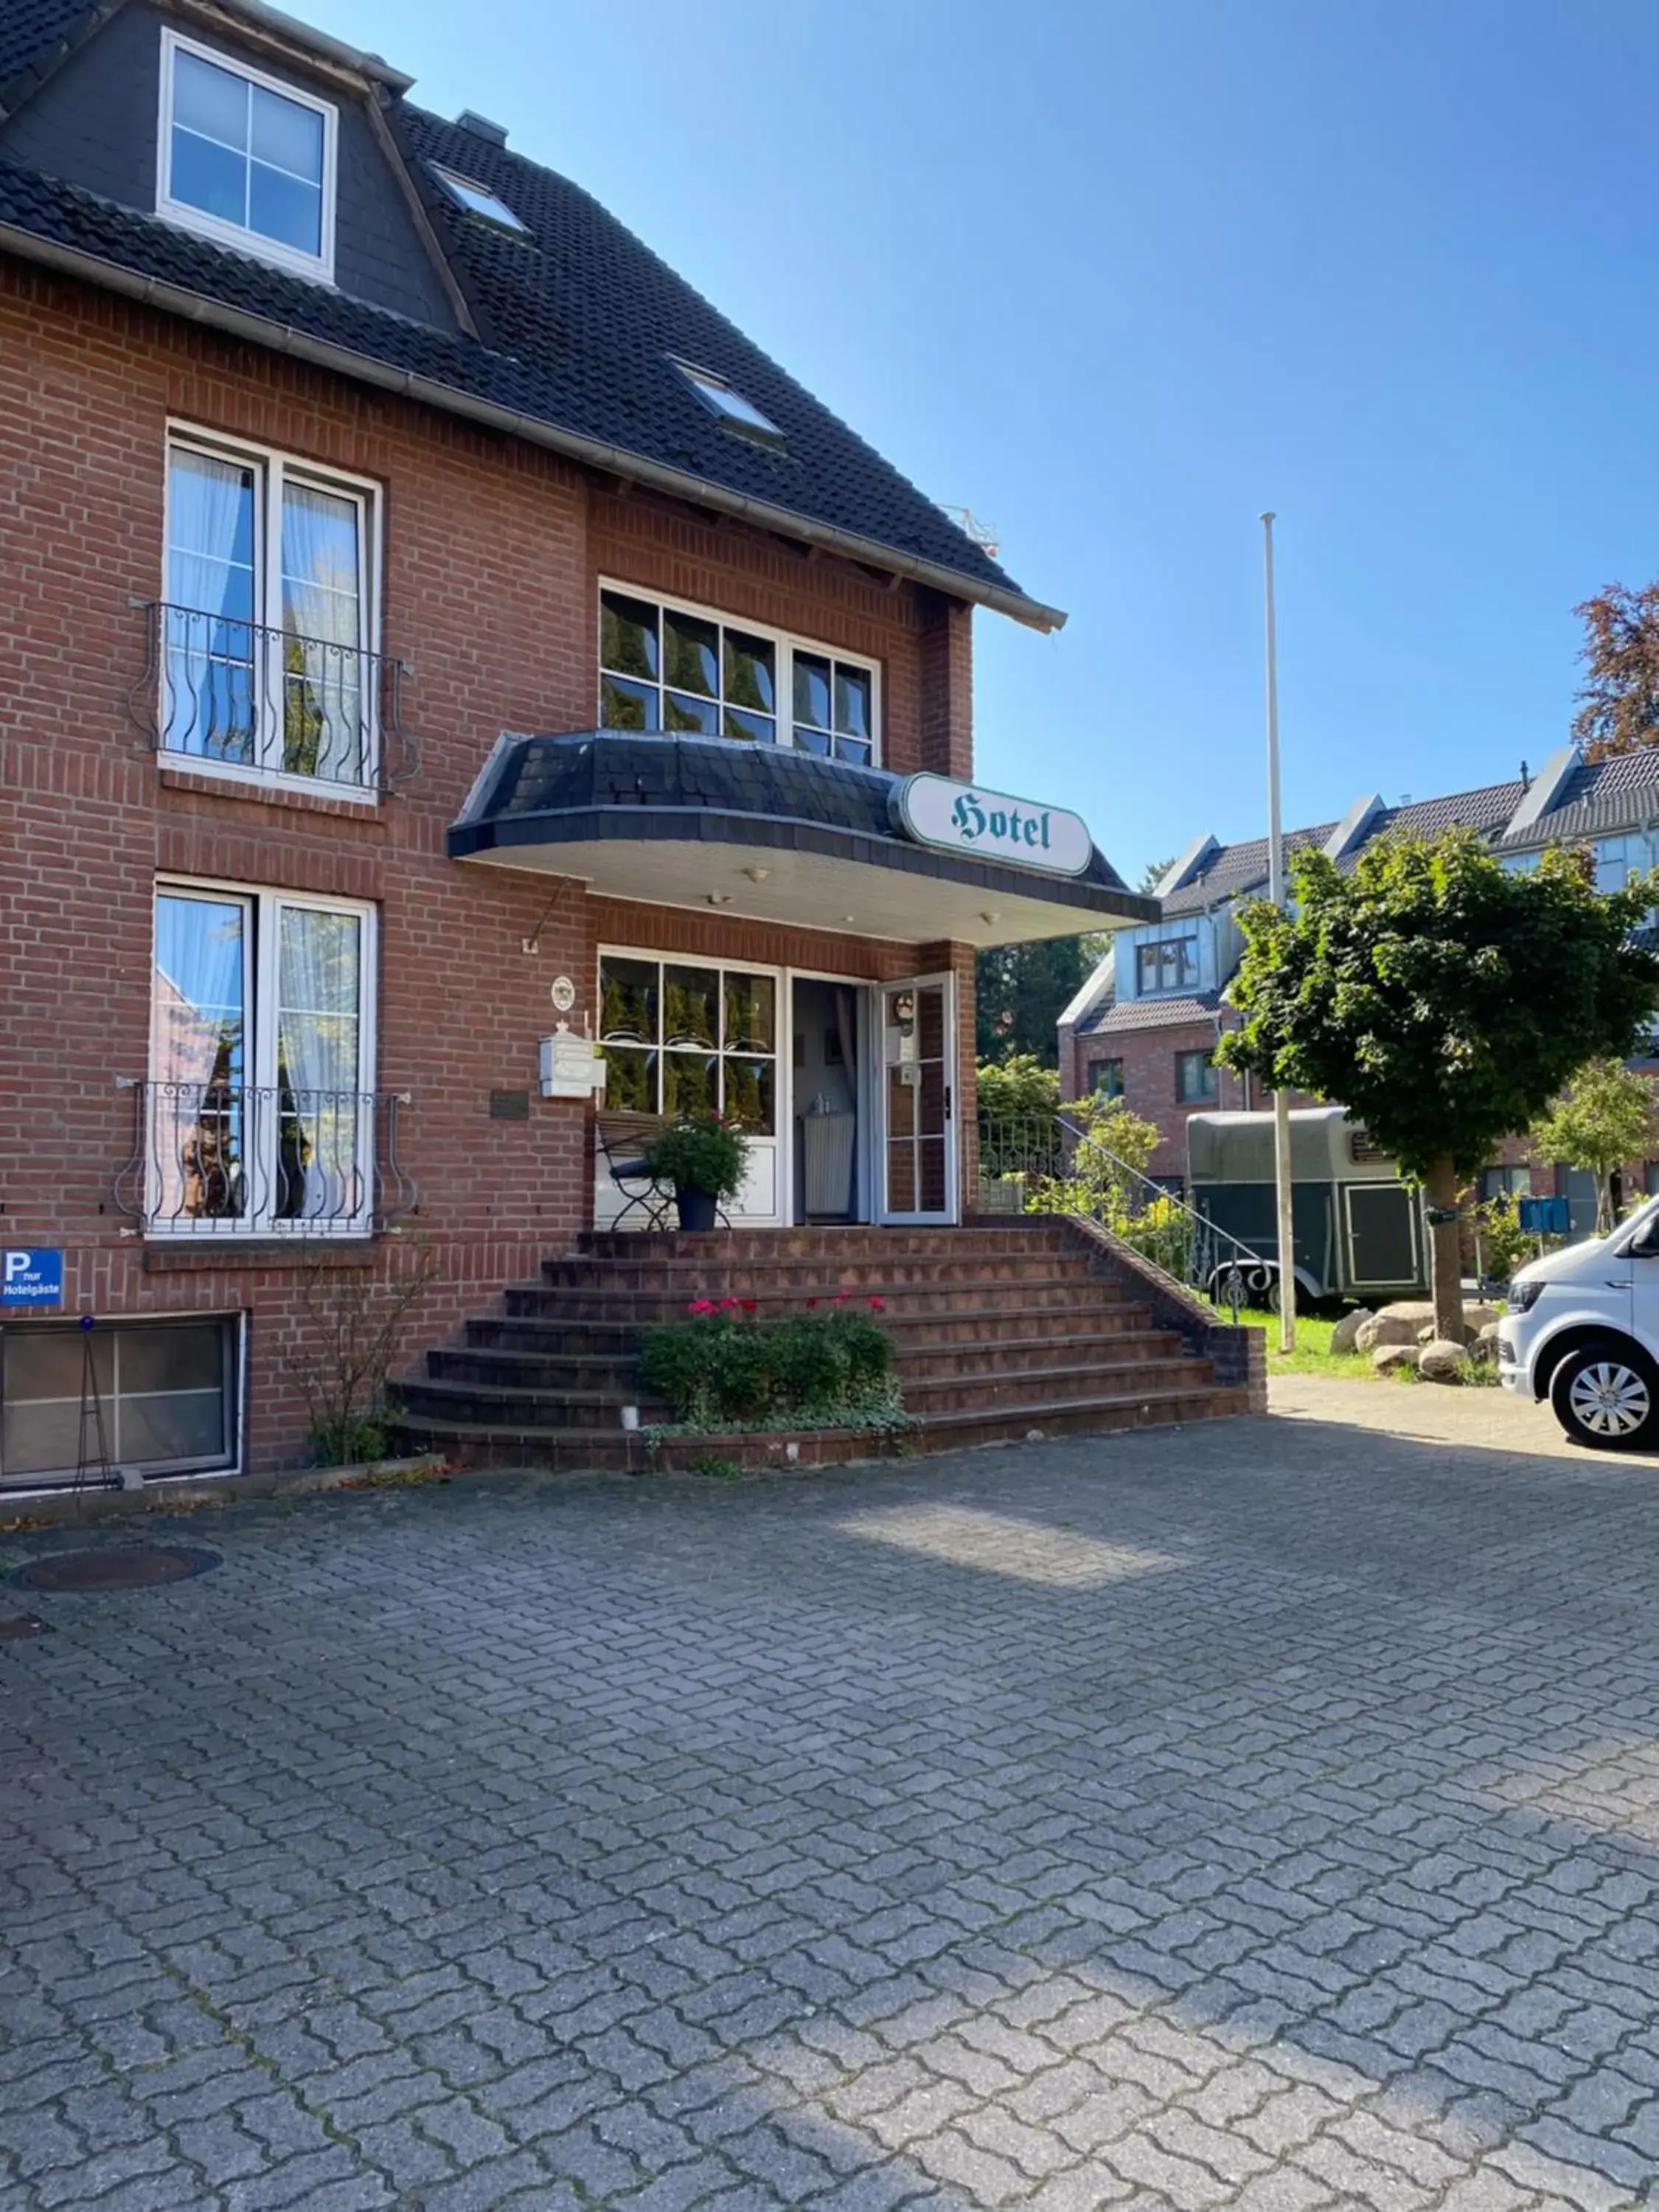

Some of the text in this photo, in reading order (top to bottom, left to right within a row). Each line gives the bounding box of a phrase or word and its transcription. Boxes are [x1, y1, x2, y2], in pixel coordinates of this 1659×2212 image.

[951, 793, 1051, 849] Hotel
[6, 1251, 31, 1281] P
[23, 1273, 42, 1281] nur
[3, 1284, 60, 1296] Hotelgäste
